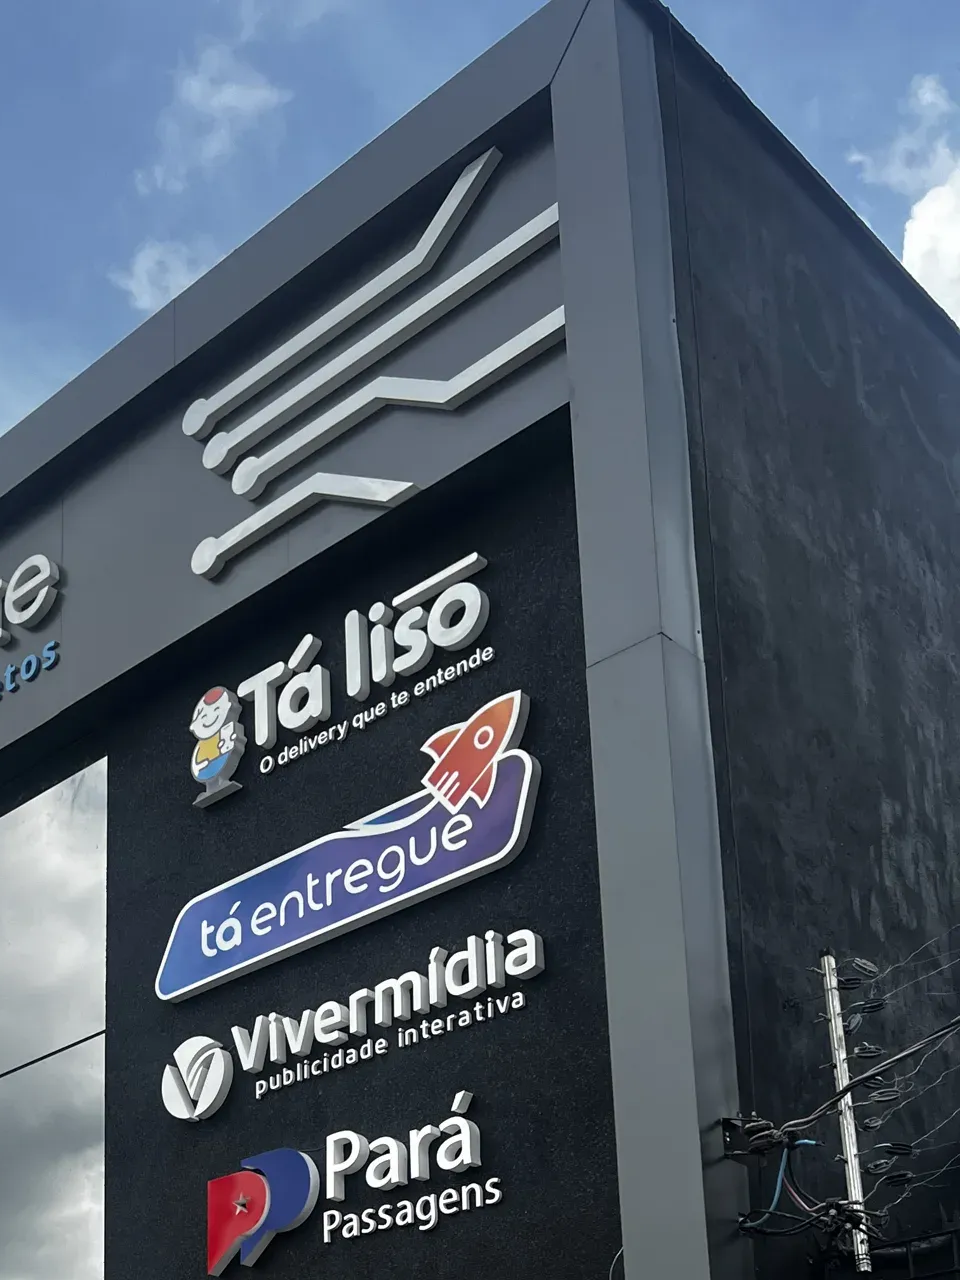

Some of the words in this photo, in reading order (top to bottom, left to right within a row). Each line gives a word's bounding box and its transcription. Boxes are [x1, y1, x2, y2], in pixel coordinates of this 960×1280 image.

[237, 633, 331, 750] Tá
[259, 756, 276, 776] O
[277, 721, 349, 767] delivery
[352, 701, 388, 733] que
[390, 687, 410, 711] te
[413, 645, 496, 698] entende
[200, 900, 243, 958] tá
[250, 813, 474, 936] entregue
[231, 928, 546, 1074] Vivermídia
[255, 1037, 389, 1100] publicidade
[397, 990, 526, 1048] interativa
[326, 1090, 483, 1202] Pará
[322, 1177, 503, 1244] Passagens
